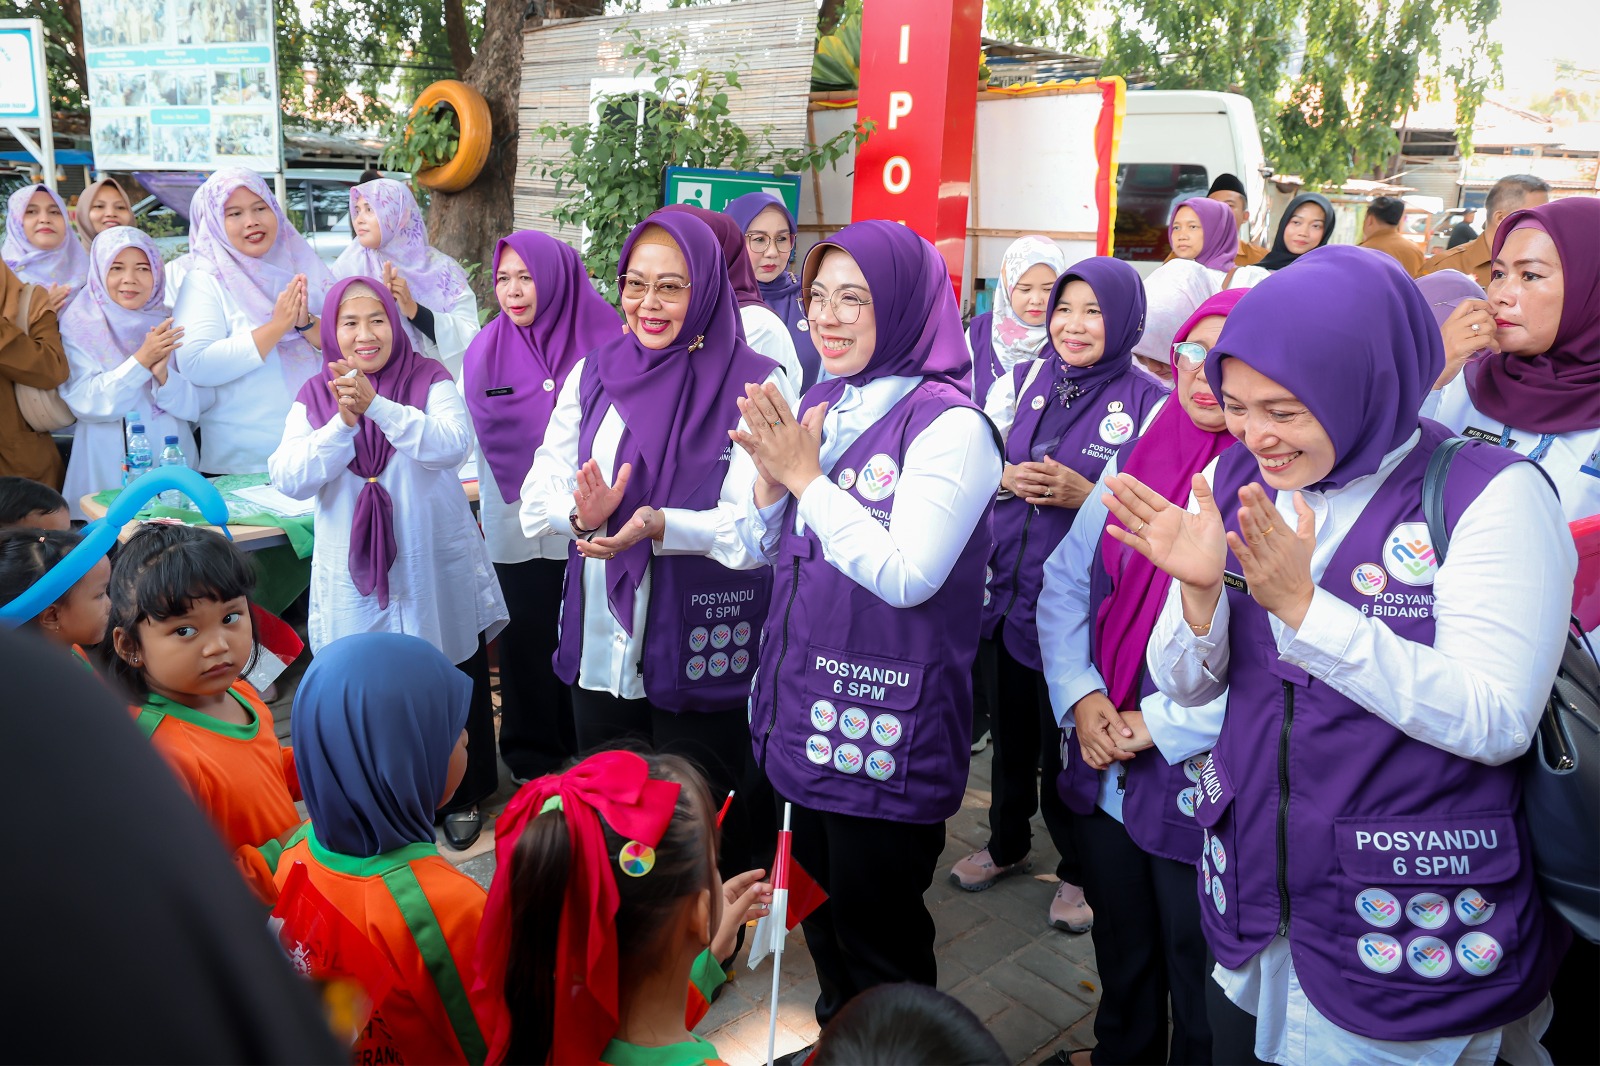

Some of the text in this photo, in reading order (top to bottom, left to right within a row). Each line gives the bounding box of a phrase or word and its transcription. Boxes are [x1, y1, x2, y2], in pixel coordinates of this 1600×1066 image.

[691, 589, 754, 606] POSYANDU
[1374, 592, 1436, 605] POSYAND
[705, 605, 741, 619] 6 SPM
[1361, 603, 1369, 614] 6
[1373, 604, 1429, 618] BIDANG
[815, 656, 910, 687] POSYANDU
[833, 679, 886, 701] 6 SPM
[1355, 829, 1498, 851] POSYANDU
[1392, 855, 1470, 876] 6 SPM
